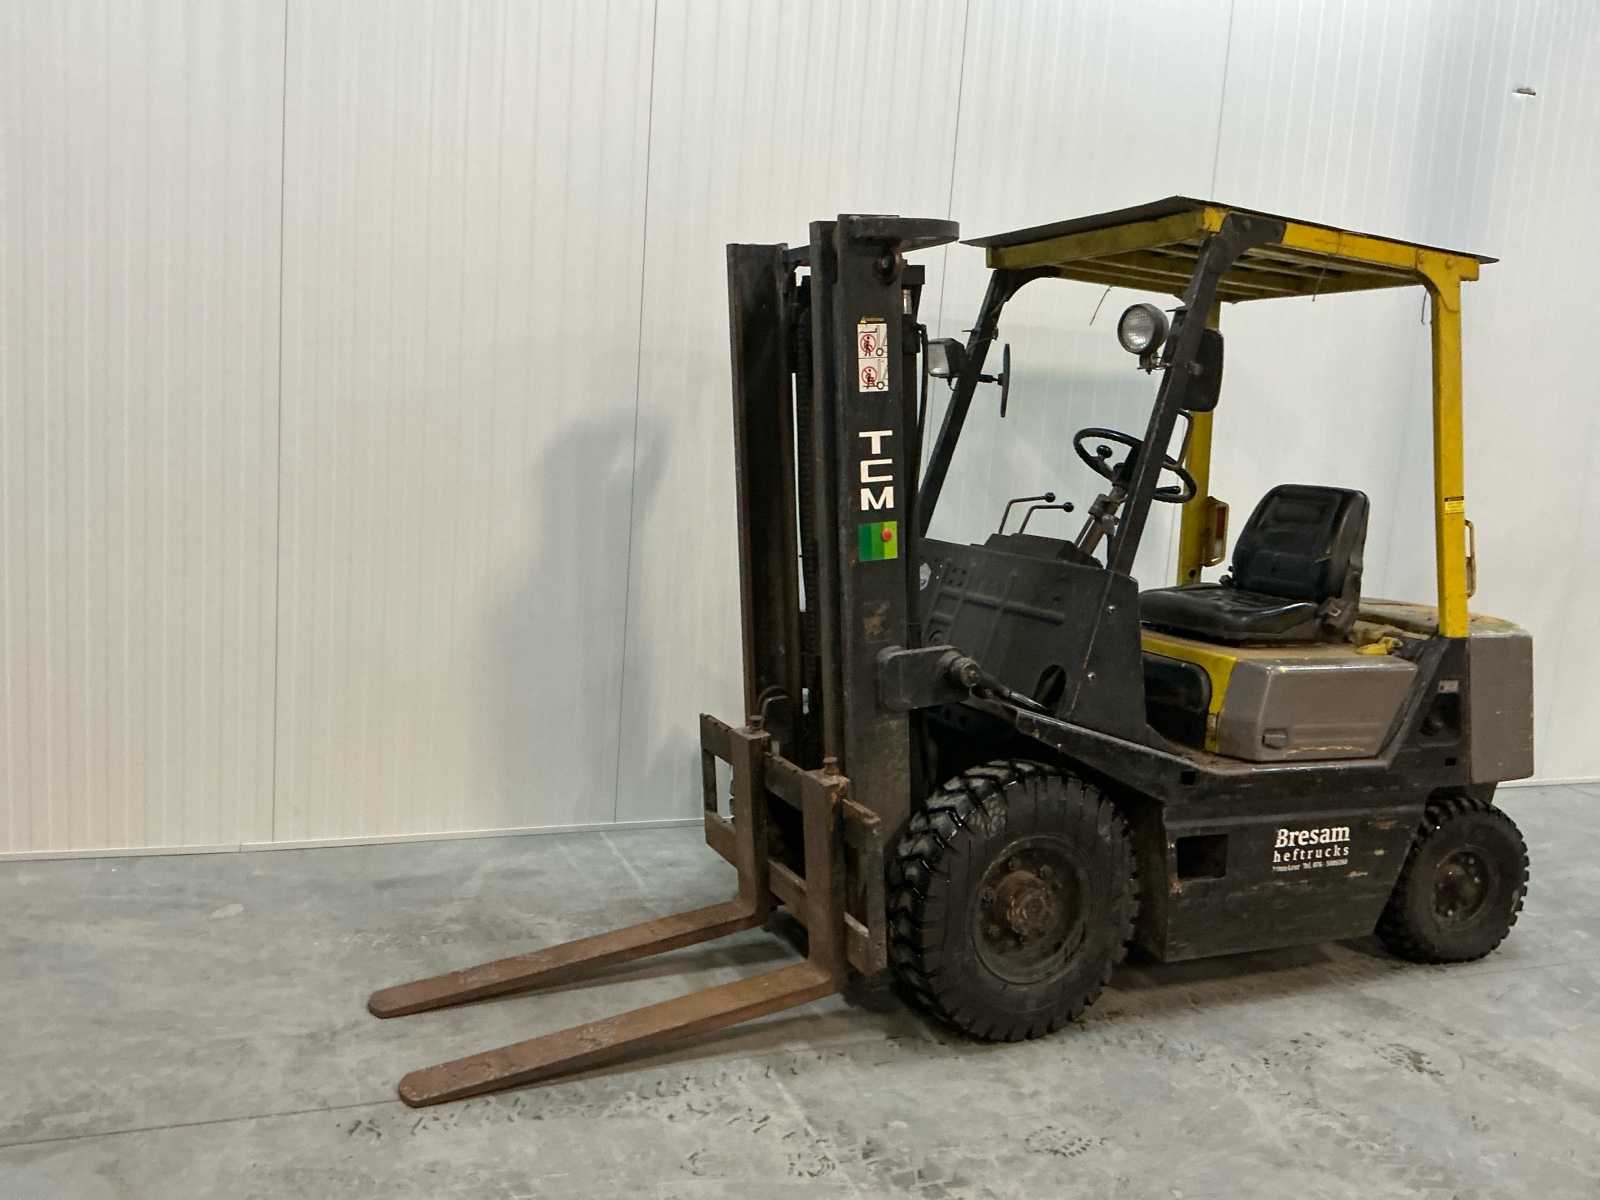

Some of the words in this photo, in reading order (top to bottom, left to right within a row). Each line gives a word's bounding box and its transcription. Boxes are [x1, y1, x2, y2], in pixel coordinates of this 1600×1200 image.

[858, 430, 895, 511] TCM
[1274, 826, 1350, 848] Bresam
[1272, 844, 1350, 863] heftrucks
